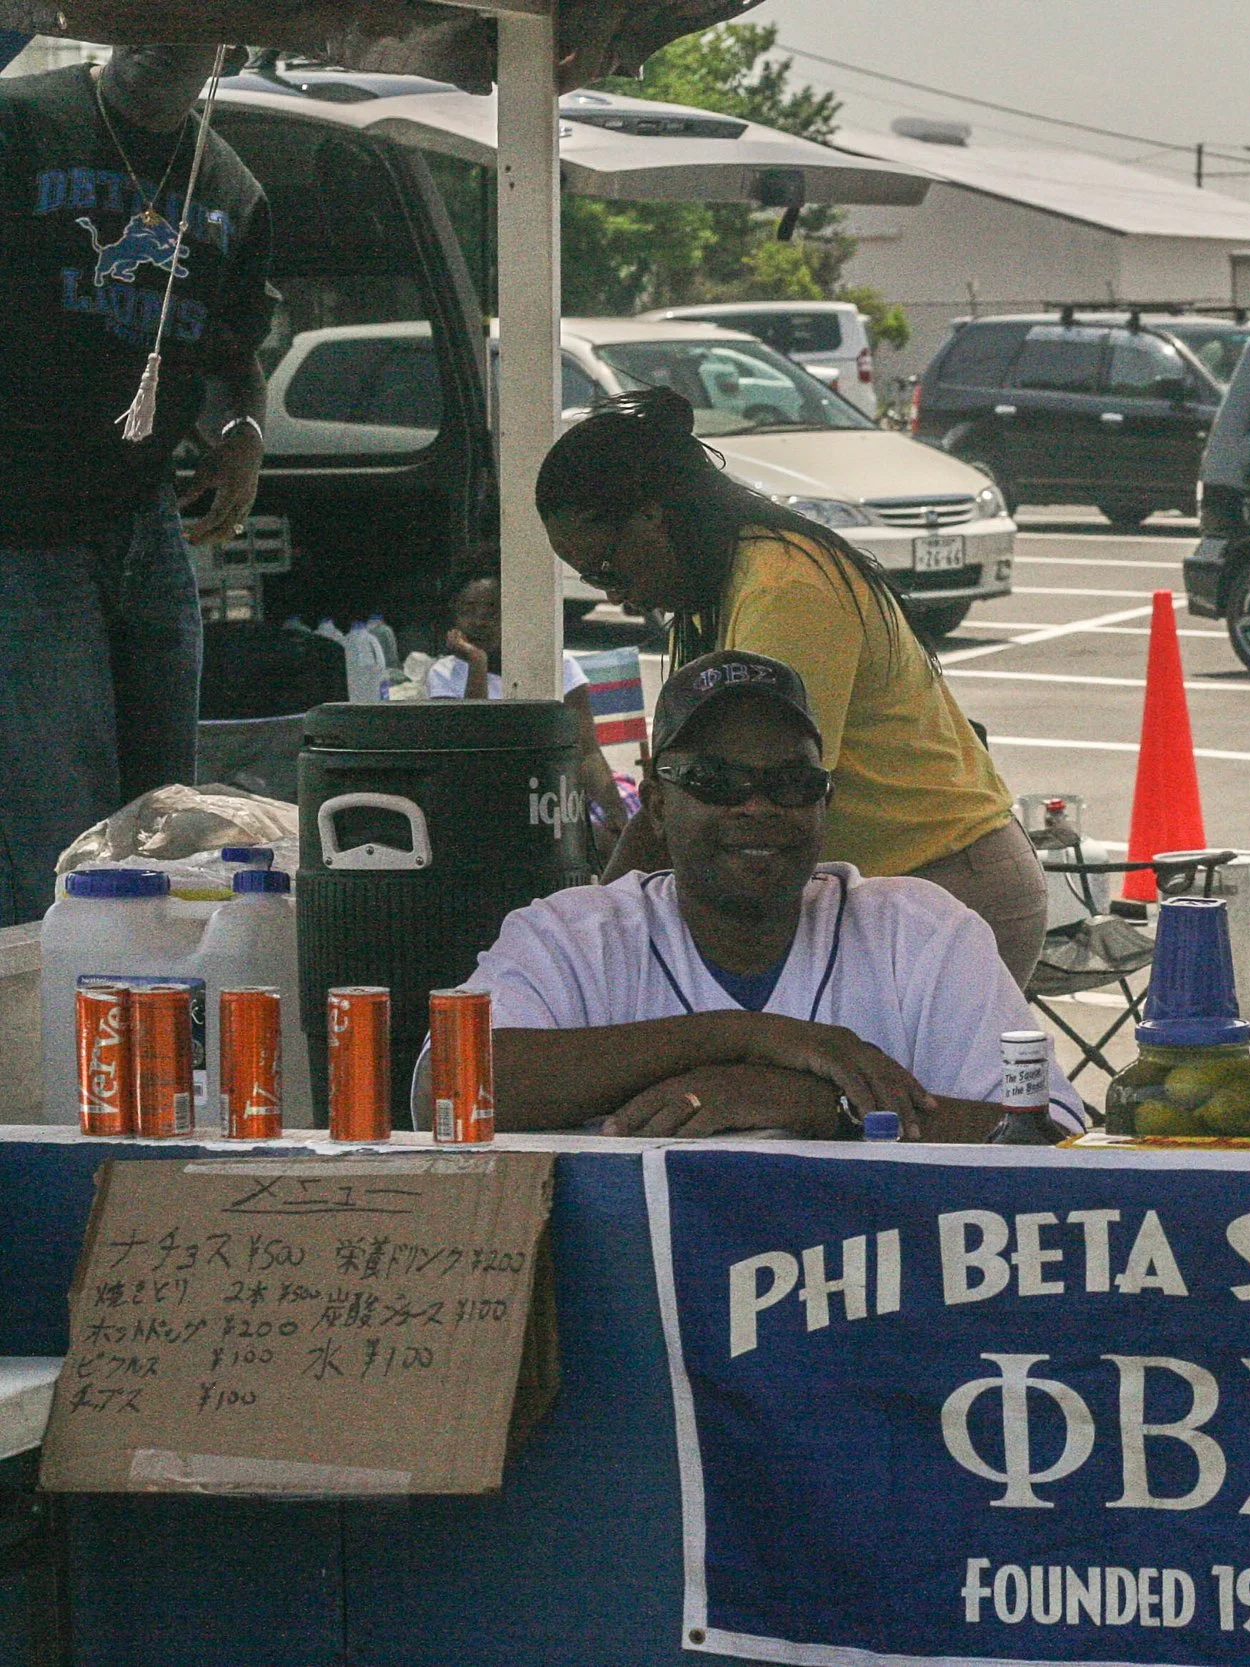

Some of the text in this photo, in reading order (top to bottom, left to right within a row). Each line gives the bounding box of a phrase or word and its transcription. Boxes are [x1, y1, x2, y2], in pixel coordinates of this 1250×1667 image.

[231, 1175, 422, 1207] メニュー
[110, 1226, 232, 1272] ナチョス
[729, 1228, 902, 1358] PHI
[938, 1208, 1189, 1305] BETA
[301, 1337, 344, 1381] 水
[961, 1557, 1196, 1628] FOUNDED
